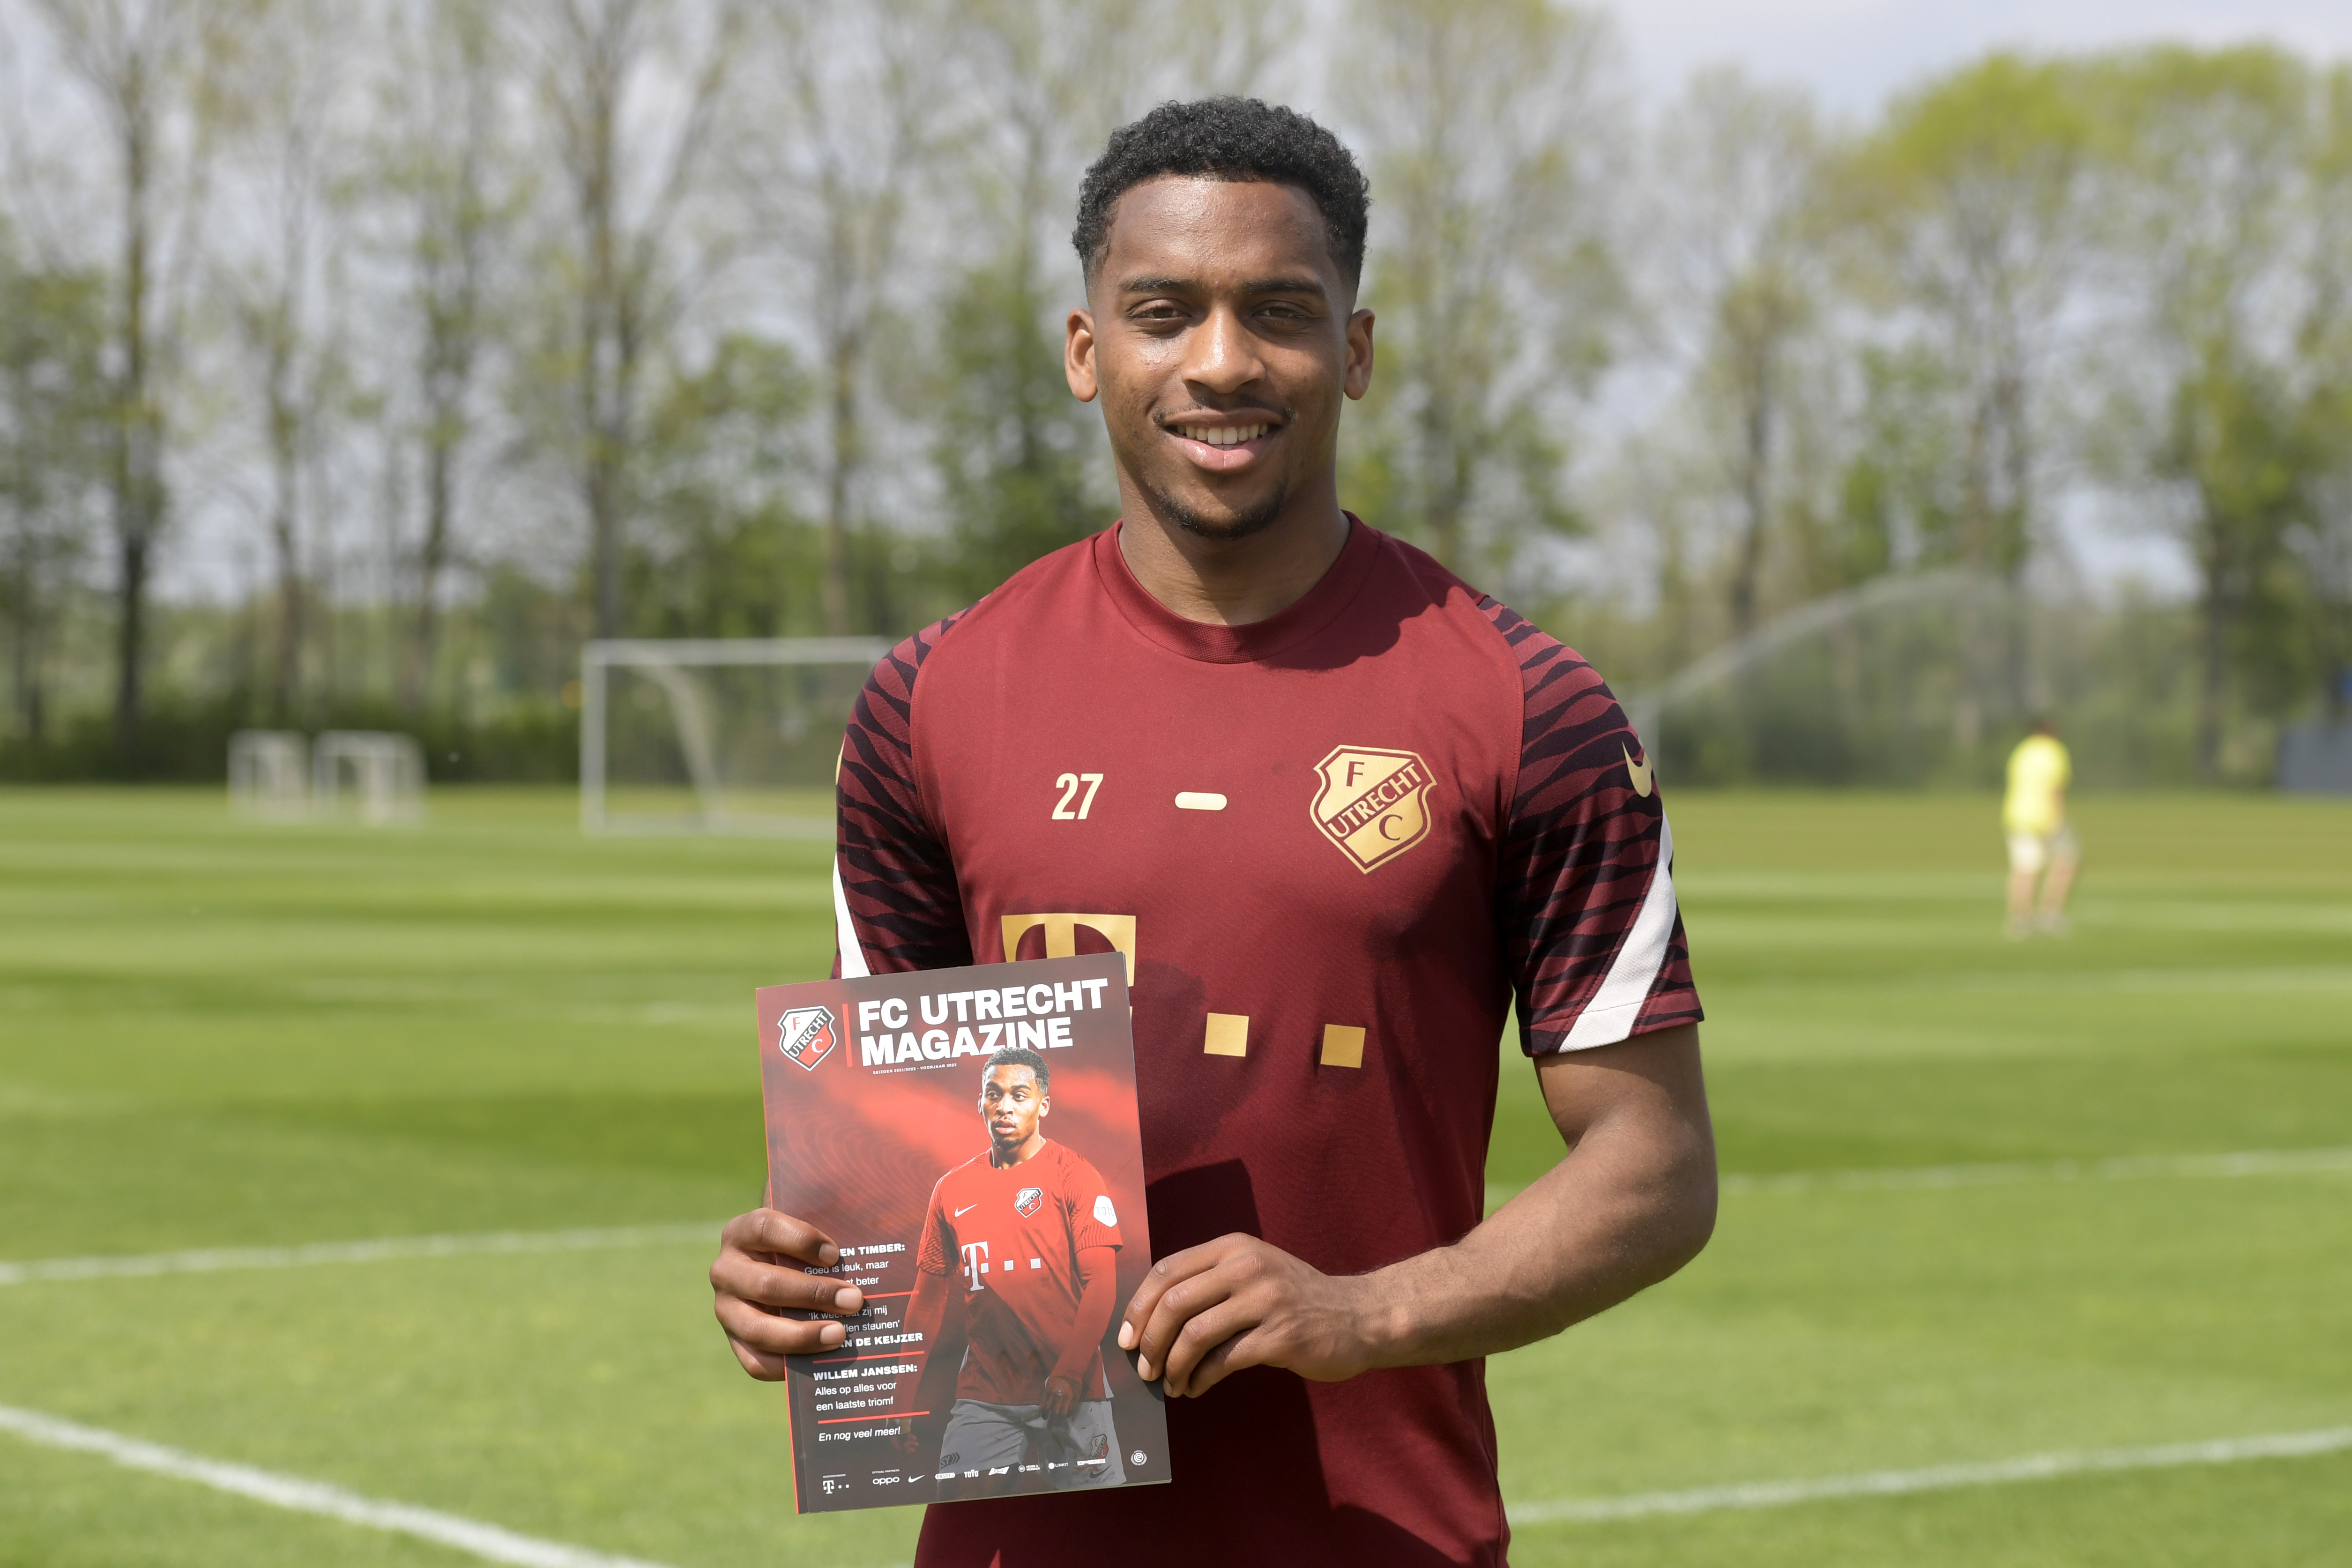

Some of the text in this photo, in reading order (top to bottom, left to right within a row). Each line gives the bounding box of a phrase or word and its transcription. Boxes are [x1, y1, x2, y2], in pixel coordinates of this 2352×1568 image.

[1346, 761, 1364, 787] F
[1051, 773, 1104, 820] 27
[1326, 762, 1422, 839] UTRECHT
[1378, 814, 1404, 841] C
[858, 978, 1109, 1032] FC UTRECHT
[792, 1017, 801, 1031] F
[789, 1011, 828, 1058] UTRECHT
[860, 1017, 1073, 1067] MAGAZINE
[811, 1038, 824, 1053] C
[1018, 1190, 1040, 1211] UTRECHT
[857, 1243, 906, 1255] TIMBER:
[842, 1262, 863, 1272] leuk,
[865, 1260, 889, 1270] maar
[856, 1277, 879, 1286] beter
[862, 1307, 872, 1317] zij
[874, 1305, 888, 1315] mij
[856, 1337, 871, 1347] DE
[874, 1332, 923, 1345] KEIJZER
[813, 1364, 918, 1381] WILLEM JANSSEN:
[815, 1382, 897, 1396] Alles op alles voor
[816, 1396, 894, 1411] een laatste triomf
[819, 1426, 901, 1442] En nog veel meer!
[964, 1469, 979, 1478] TOTO
[872, 1477, 900, 1486] oppo
